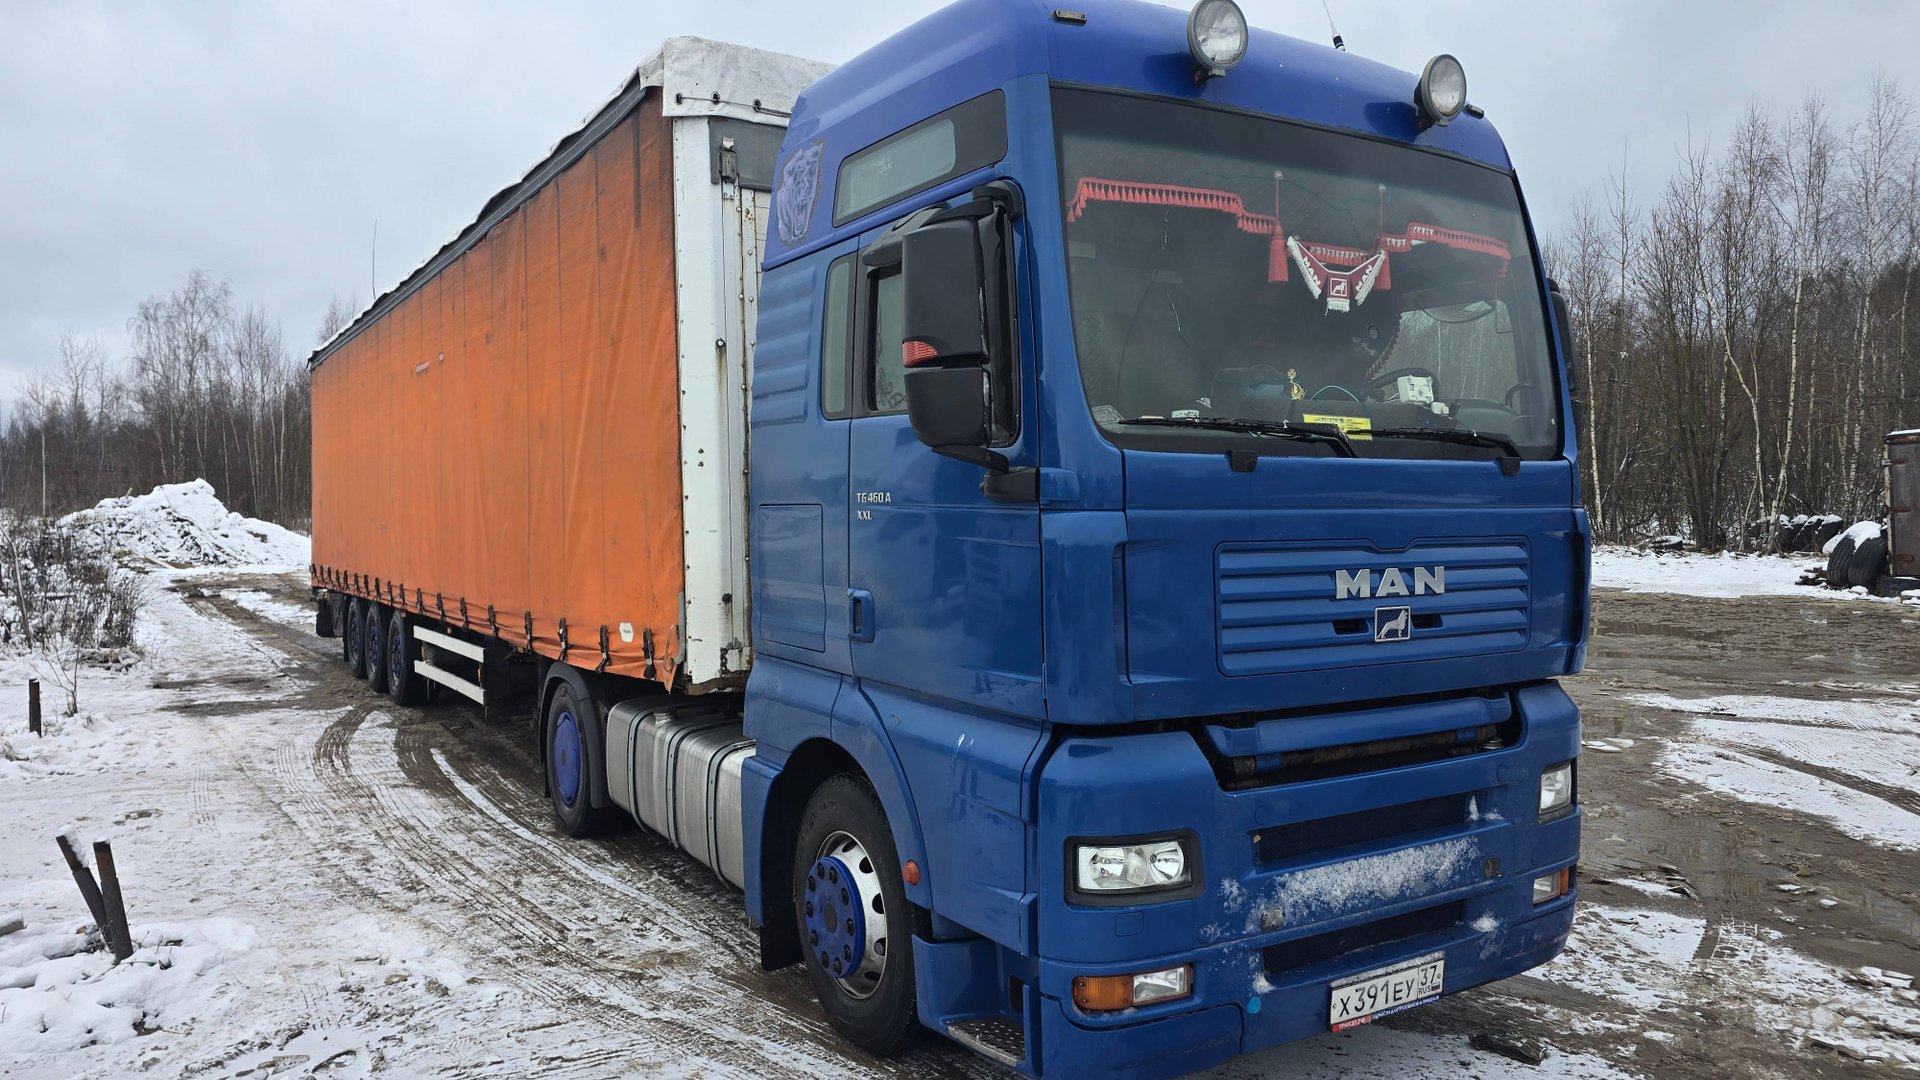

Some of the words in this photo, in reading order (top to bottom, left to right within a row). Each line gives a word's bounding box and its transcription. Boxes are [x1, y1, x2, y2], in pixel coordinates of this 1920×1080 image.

[856, 510, 873, 520] XXL
[1335, 565, 1446, 600] MAN
[1339, 977, 1415, 1018] Х391ЕУ
[1420, 964, 1437, 986] 37
[1418, 985, 1431, 996] RUS
